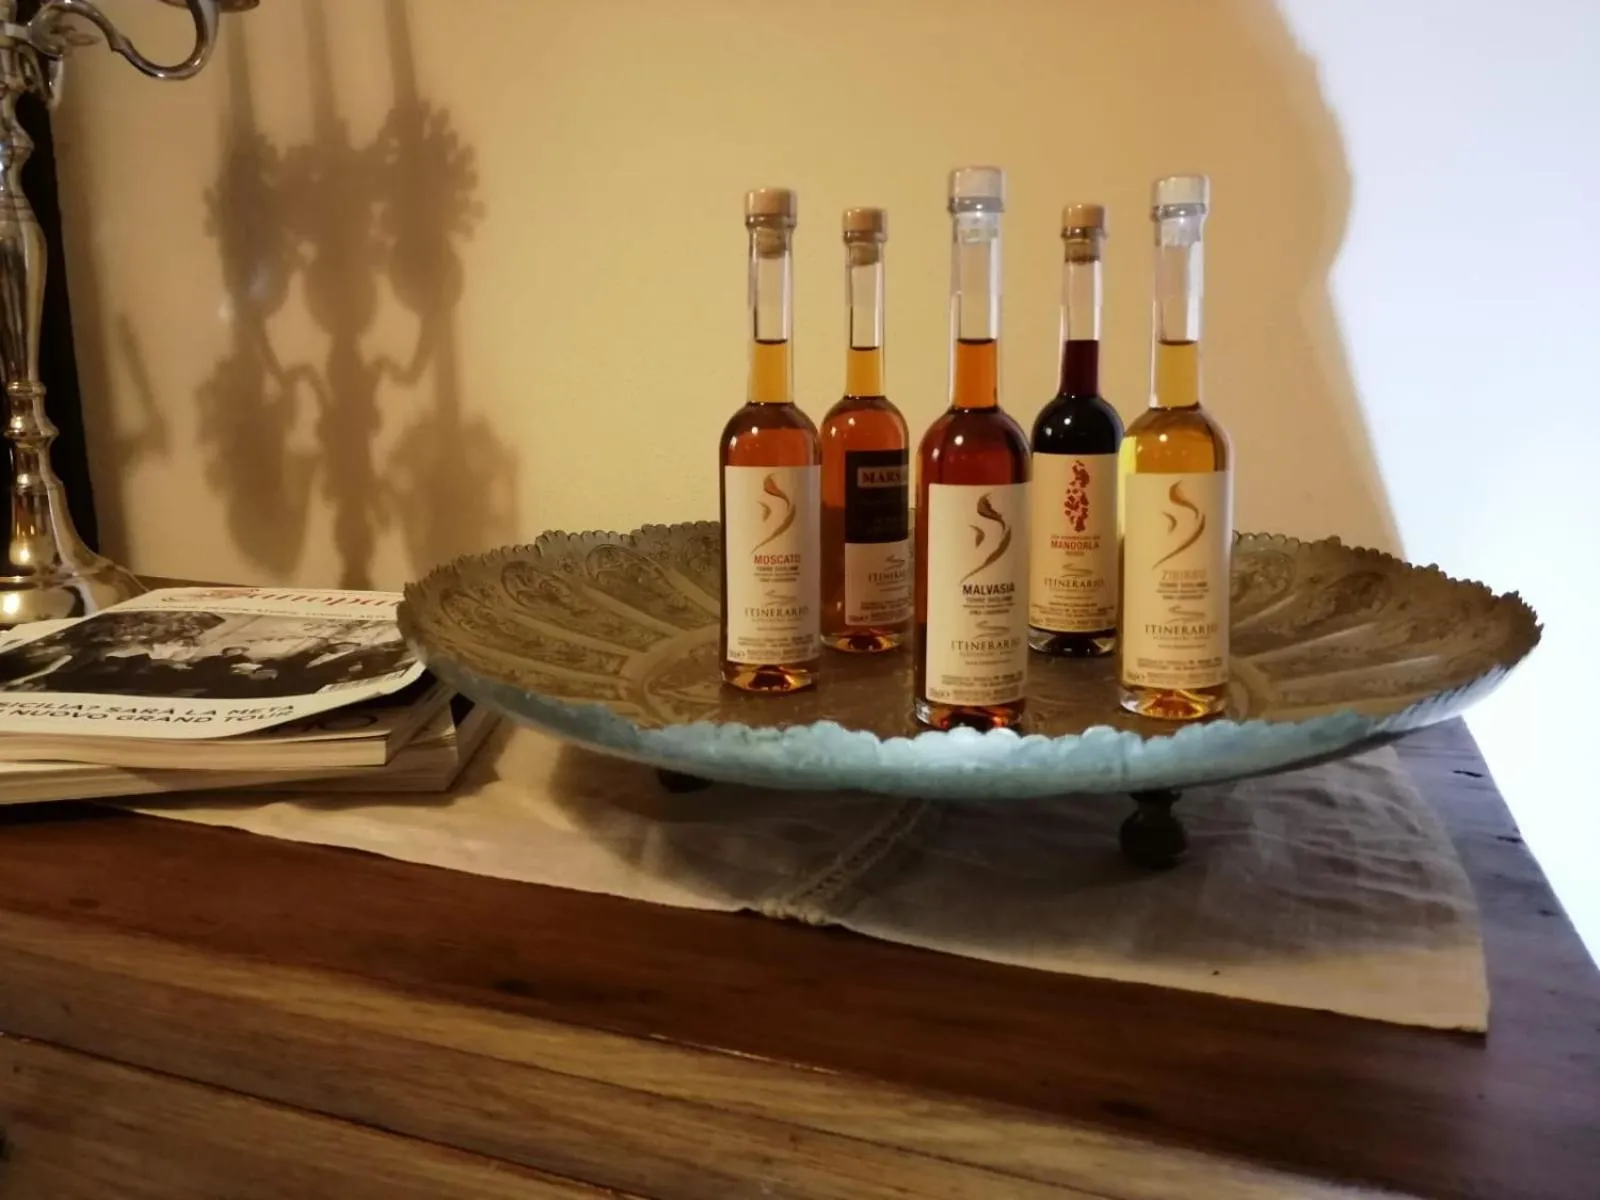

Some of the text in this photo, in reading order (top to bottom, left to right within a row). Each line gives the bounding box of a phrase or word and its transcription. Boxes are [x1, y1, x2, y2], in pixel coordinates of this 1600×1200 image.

[754, 554, 801, 565] MOSCATO
[962, 582, 1015, 596] MALVASIA
[227, 705, 294, 715] META
[9, 710, 108, 719] NUOVO
[116, 714, 212, 723] GRAND
